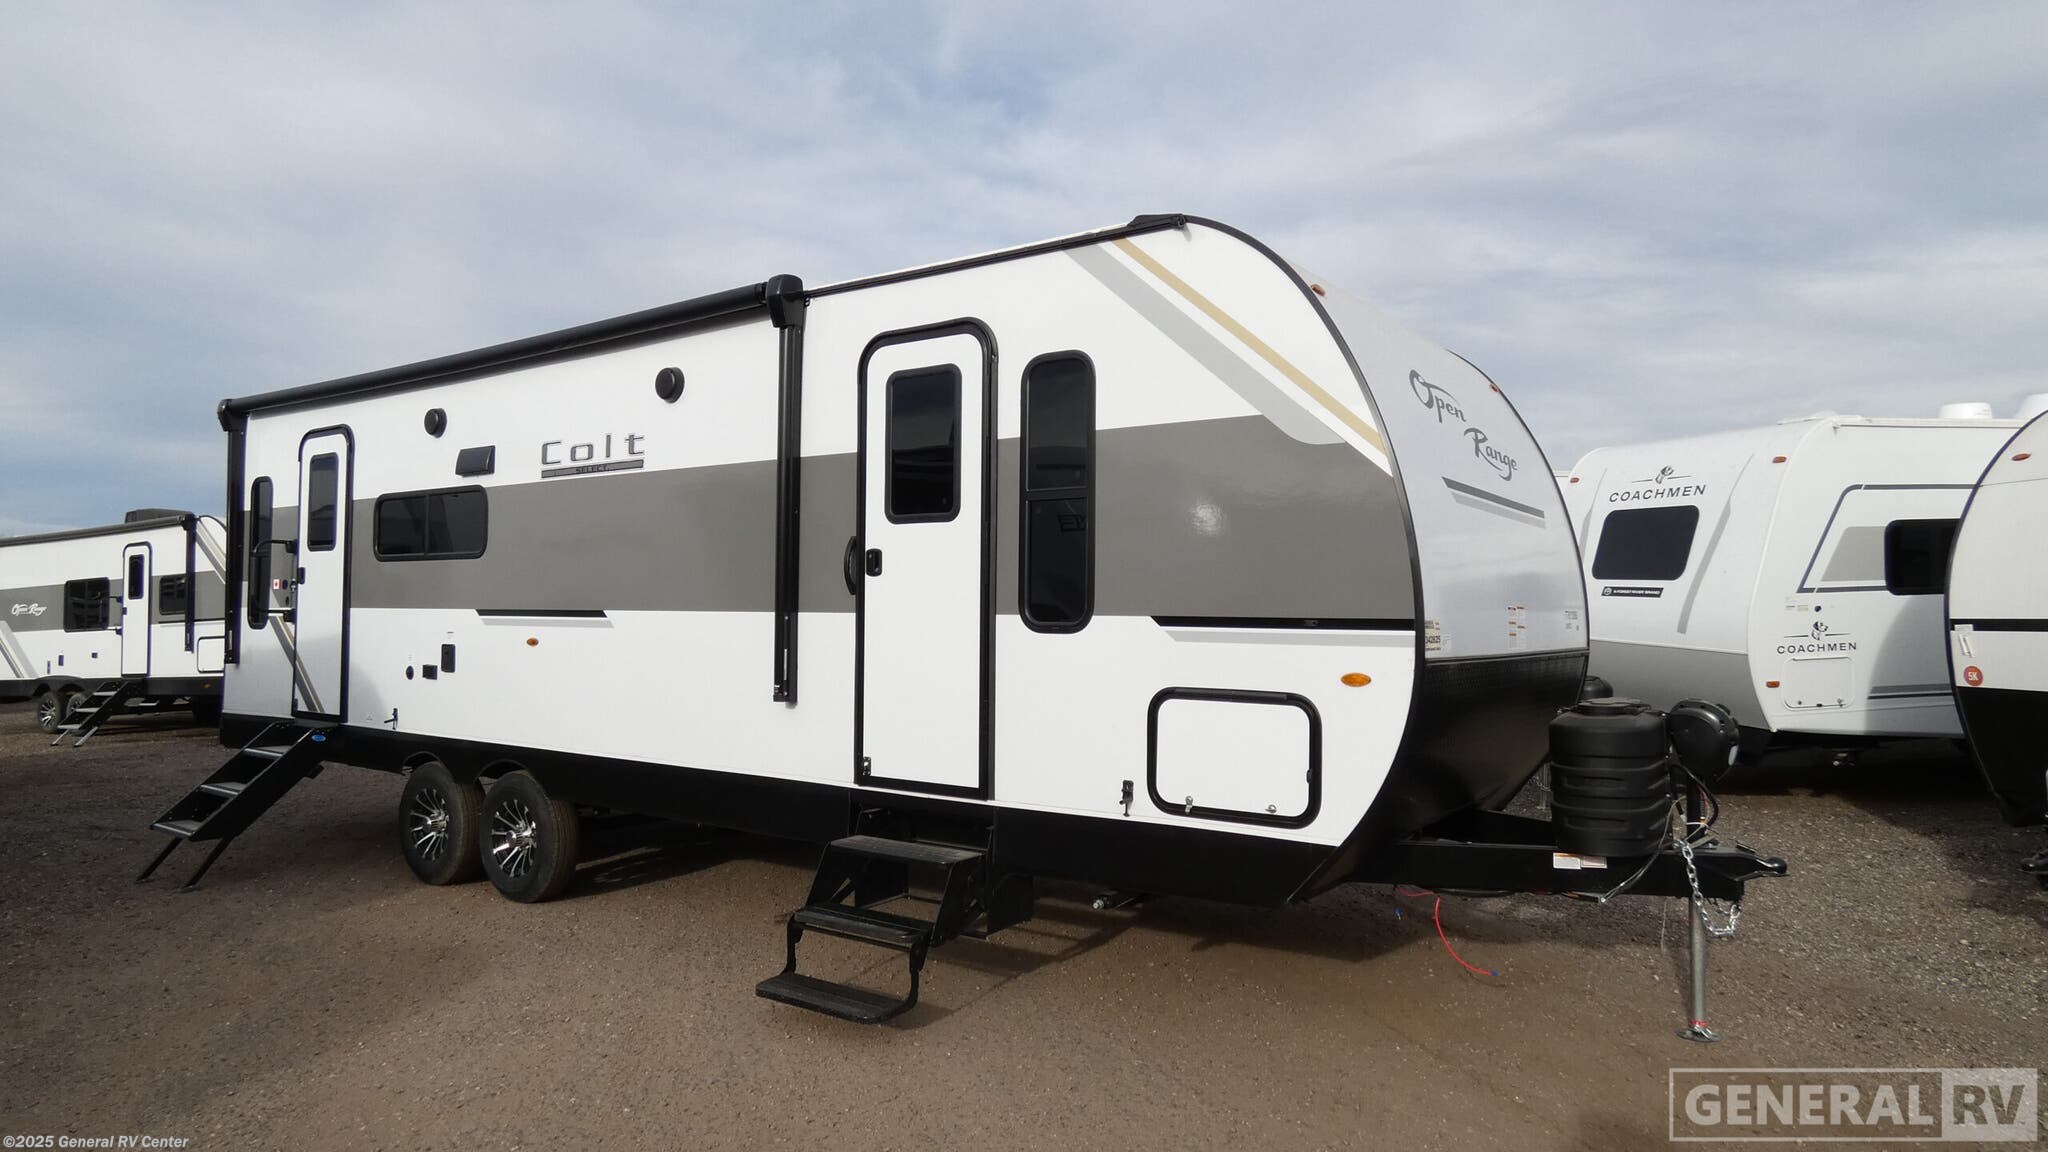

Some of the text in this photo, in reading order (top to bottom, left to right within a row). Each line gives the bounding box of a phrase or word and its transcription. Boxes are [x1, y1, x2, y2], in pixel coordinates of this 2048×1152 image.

[1409, 369, 1467, 424] Open
[541, 434, 645, 465] Colt
[1463, 427, 1518, 482] Range
[1608, 484, 1707, 503] COACHMEN
[1776, 642, 1857, 655] COACHMEN
